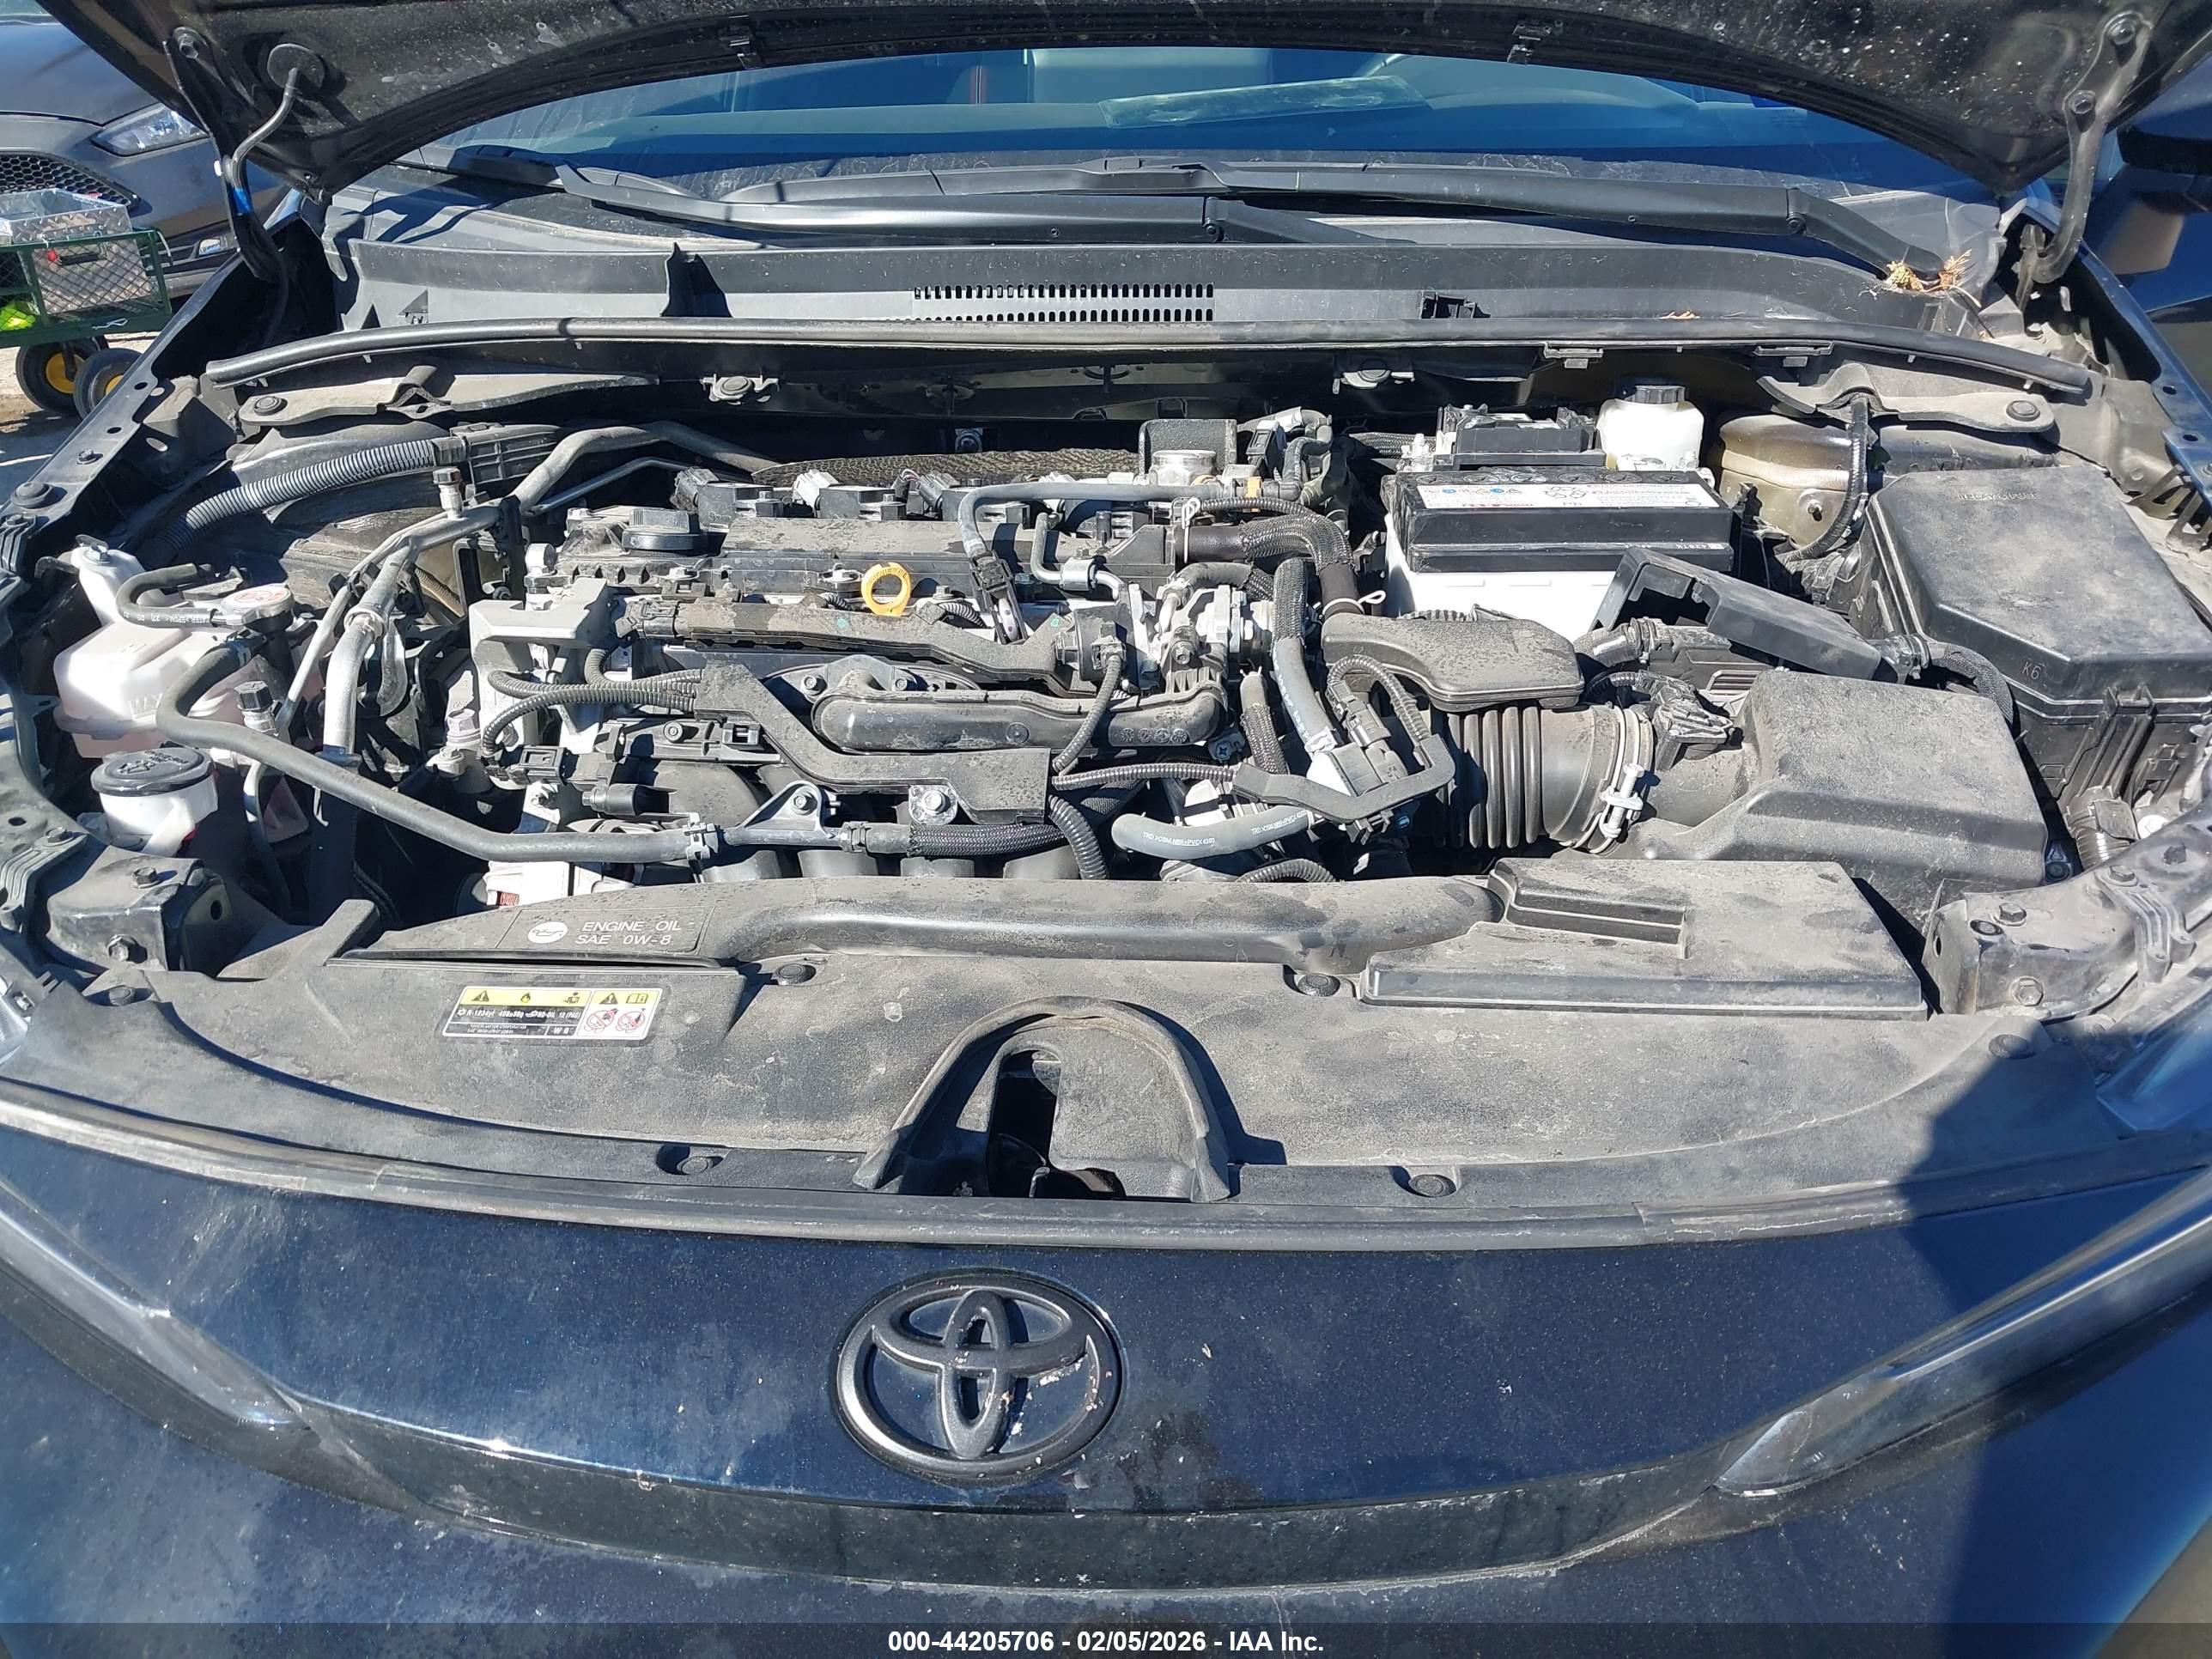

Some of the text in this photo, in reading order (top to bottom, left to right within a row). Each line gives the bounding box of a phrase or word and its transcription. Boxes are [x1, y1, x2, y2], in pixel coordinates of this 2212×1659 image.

[2021, 661, 2041, 680] K6
[581, 921, 683, 933] ENGINE OIL
[574, 934, 672, 945] SAE 0W-8
